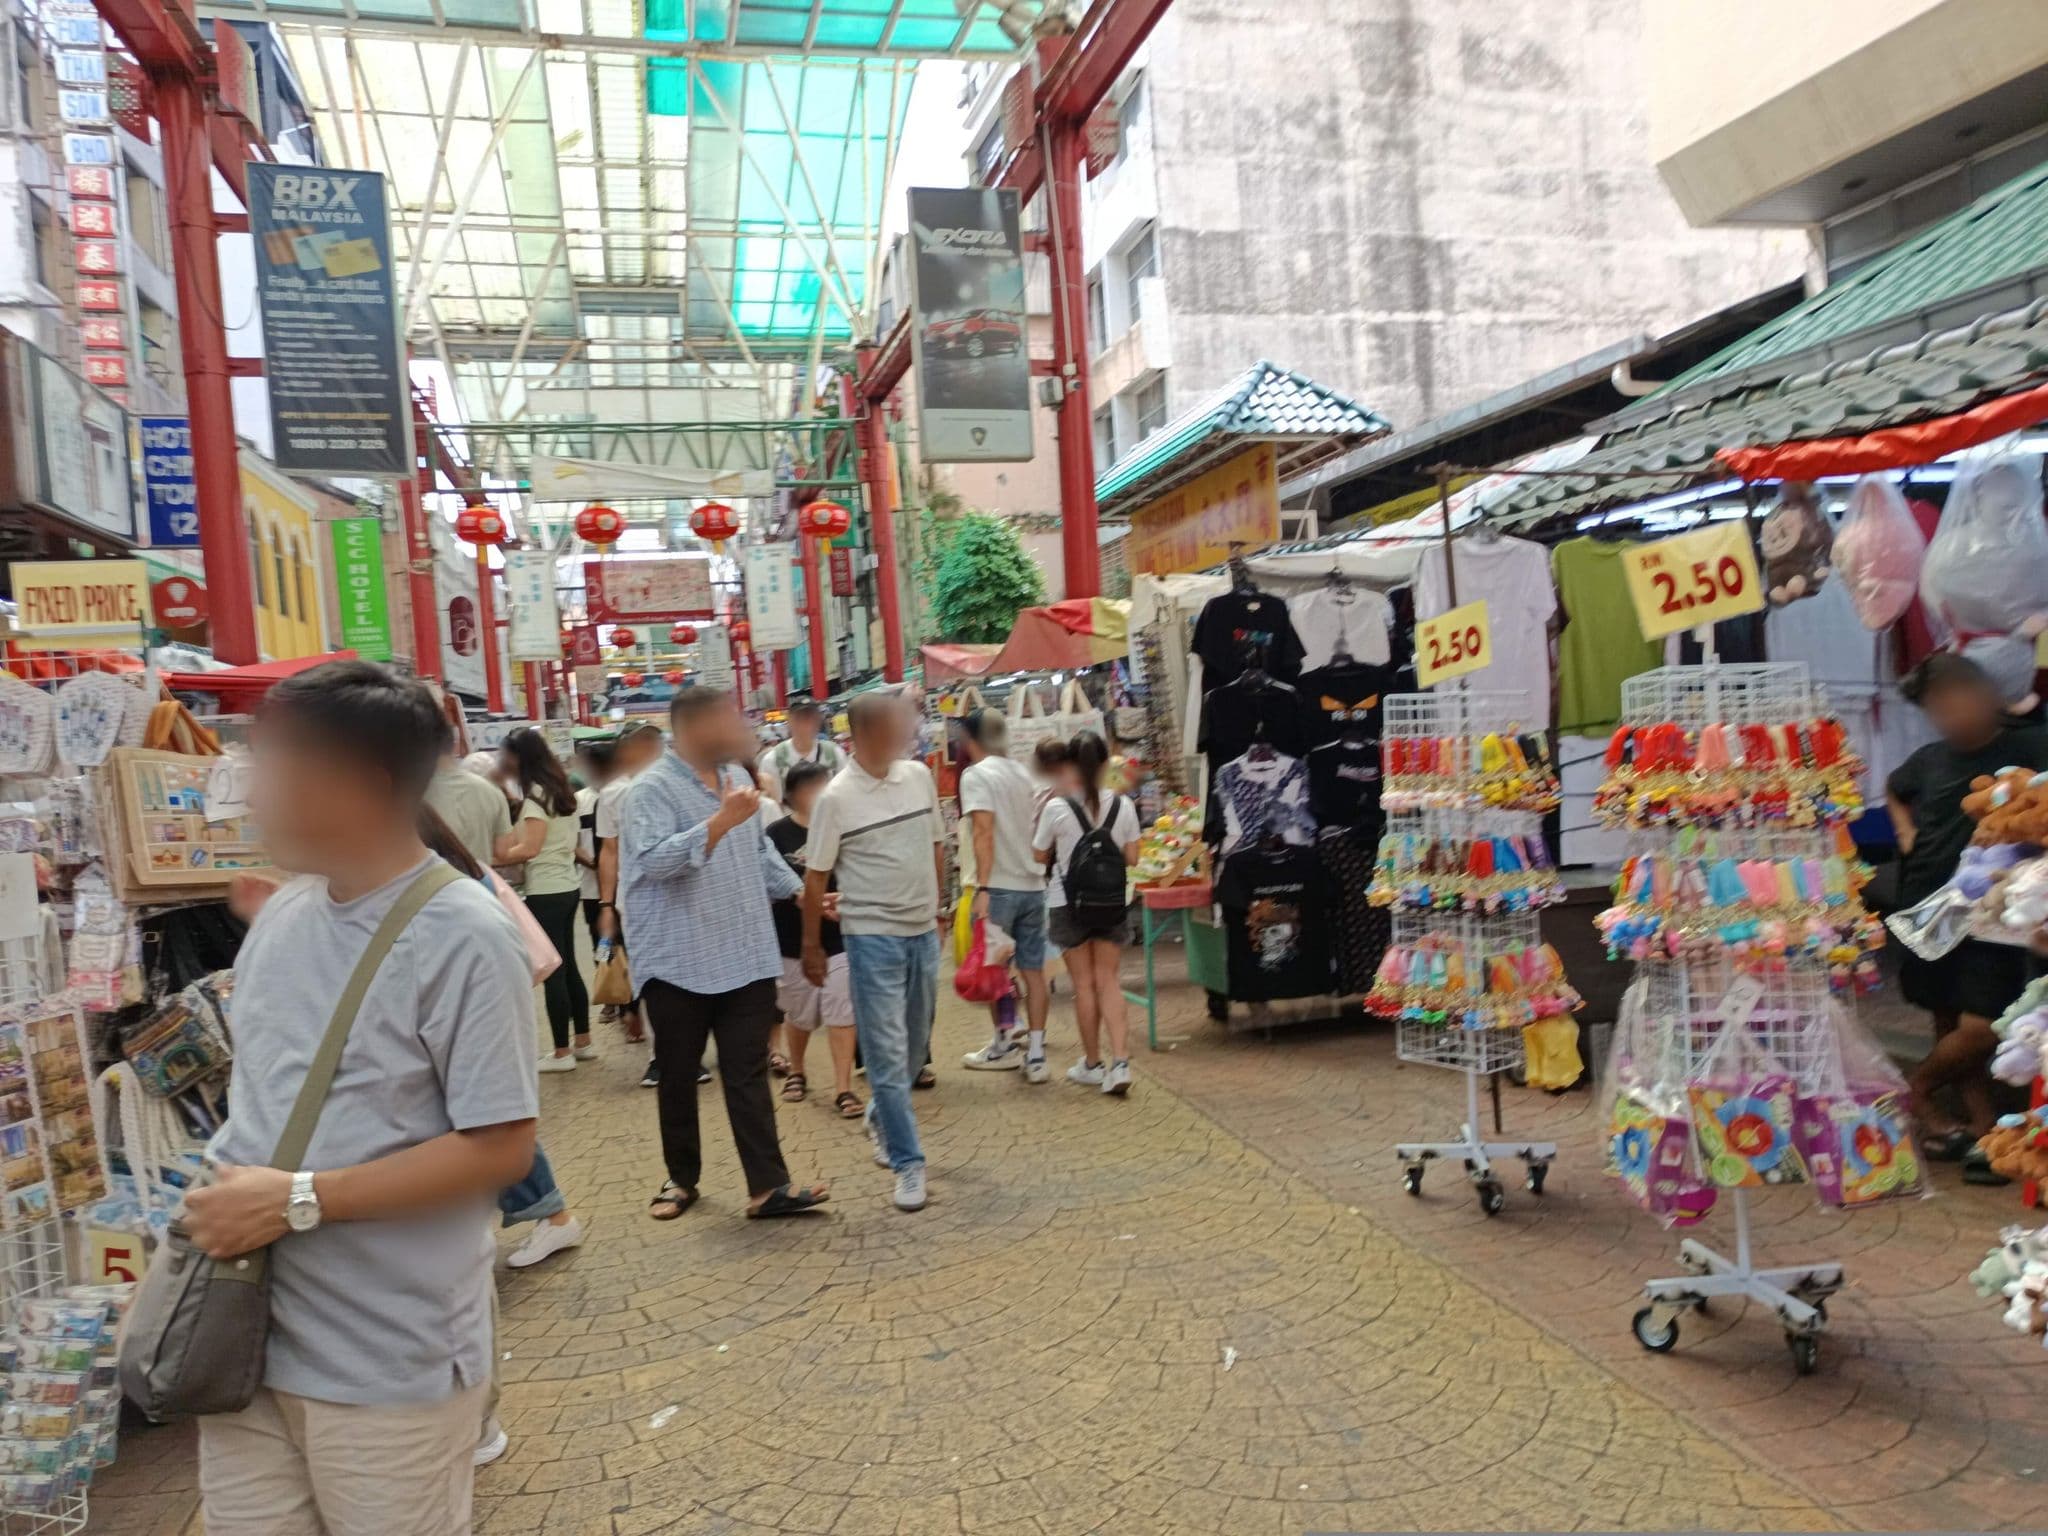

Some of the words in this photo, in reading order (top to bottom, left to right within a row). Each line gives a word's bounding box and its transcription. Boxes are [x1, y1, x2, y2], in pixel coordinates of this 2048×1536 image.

[273, 174, 361, 210] BBX
[271, 208, 364, 224] MALAYSIA
[24, 586, 79, 624] FIXED
[83, 583, 142, 622] PRICE
[1652, 555, 1744, 615] 2.50
[1429, 625, 1481, 671] 2.50
